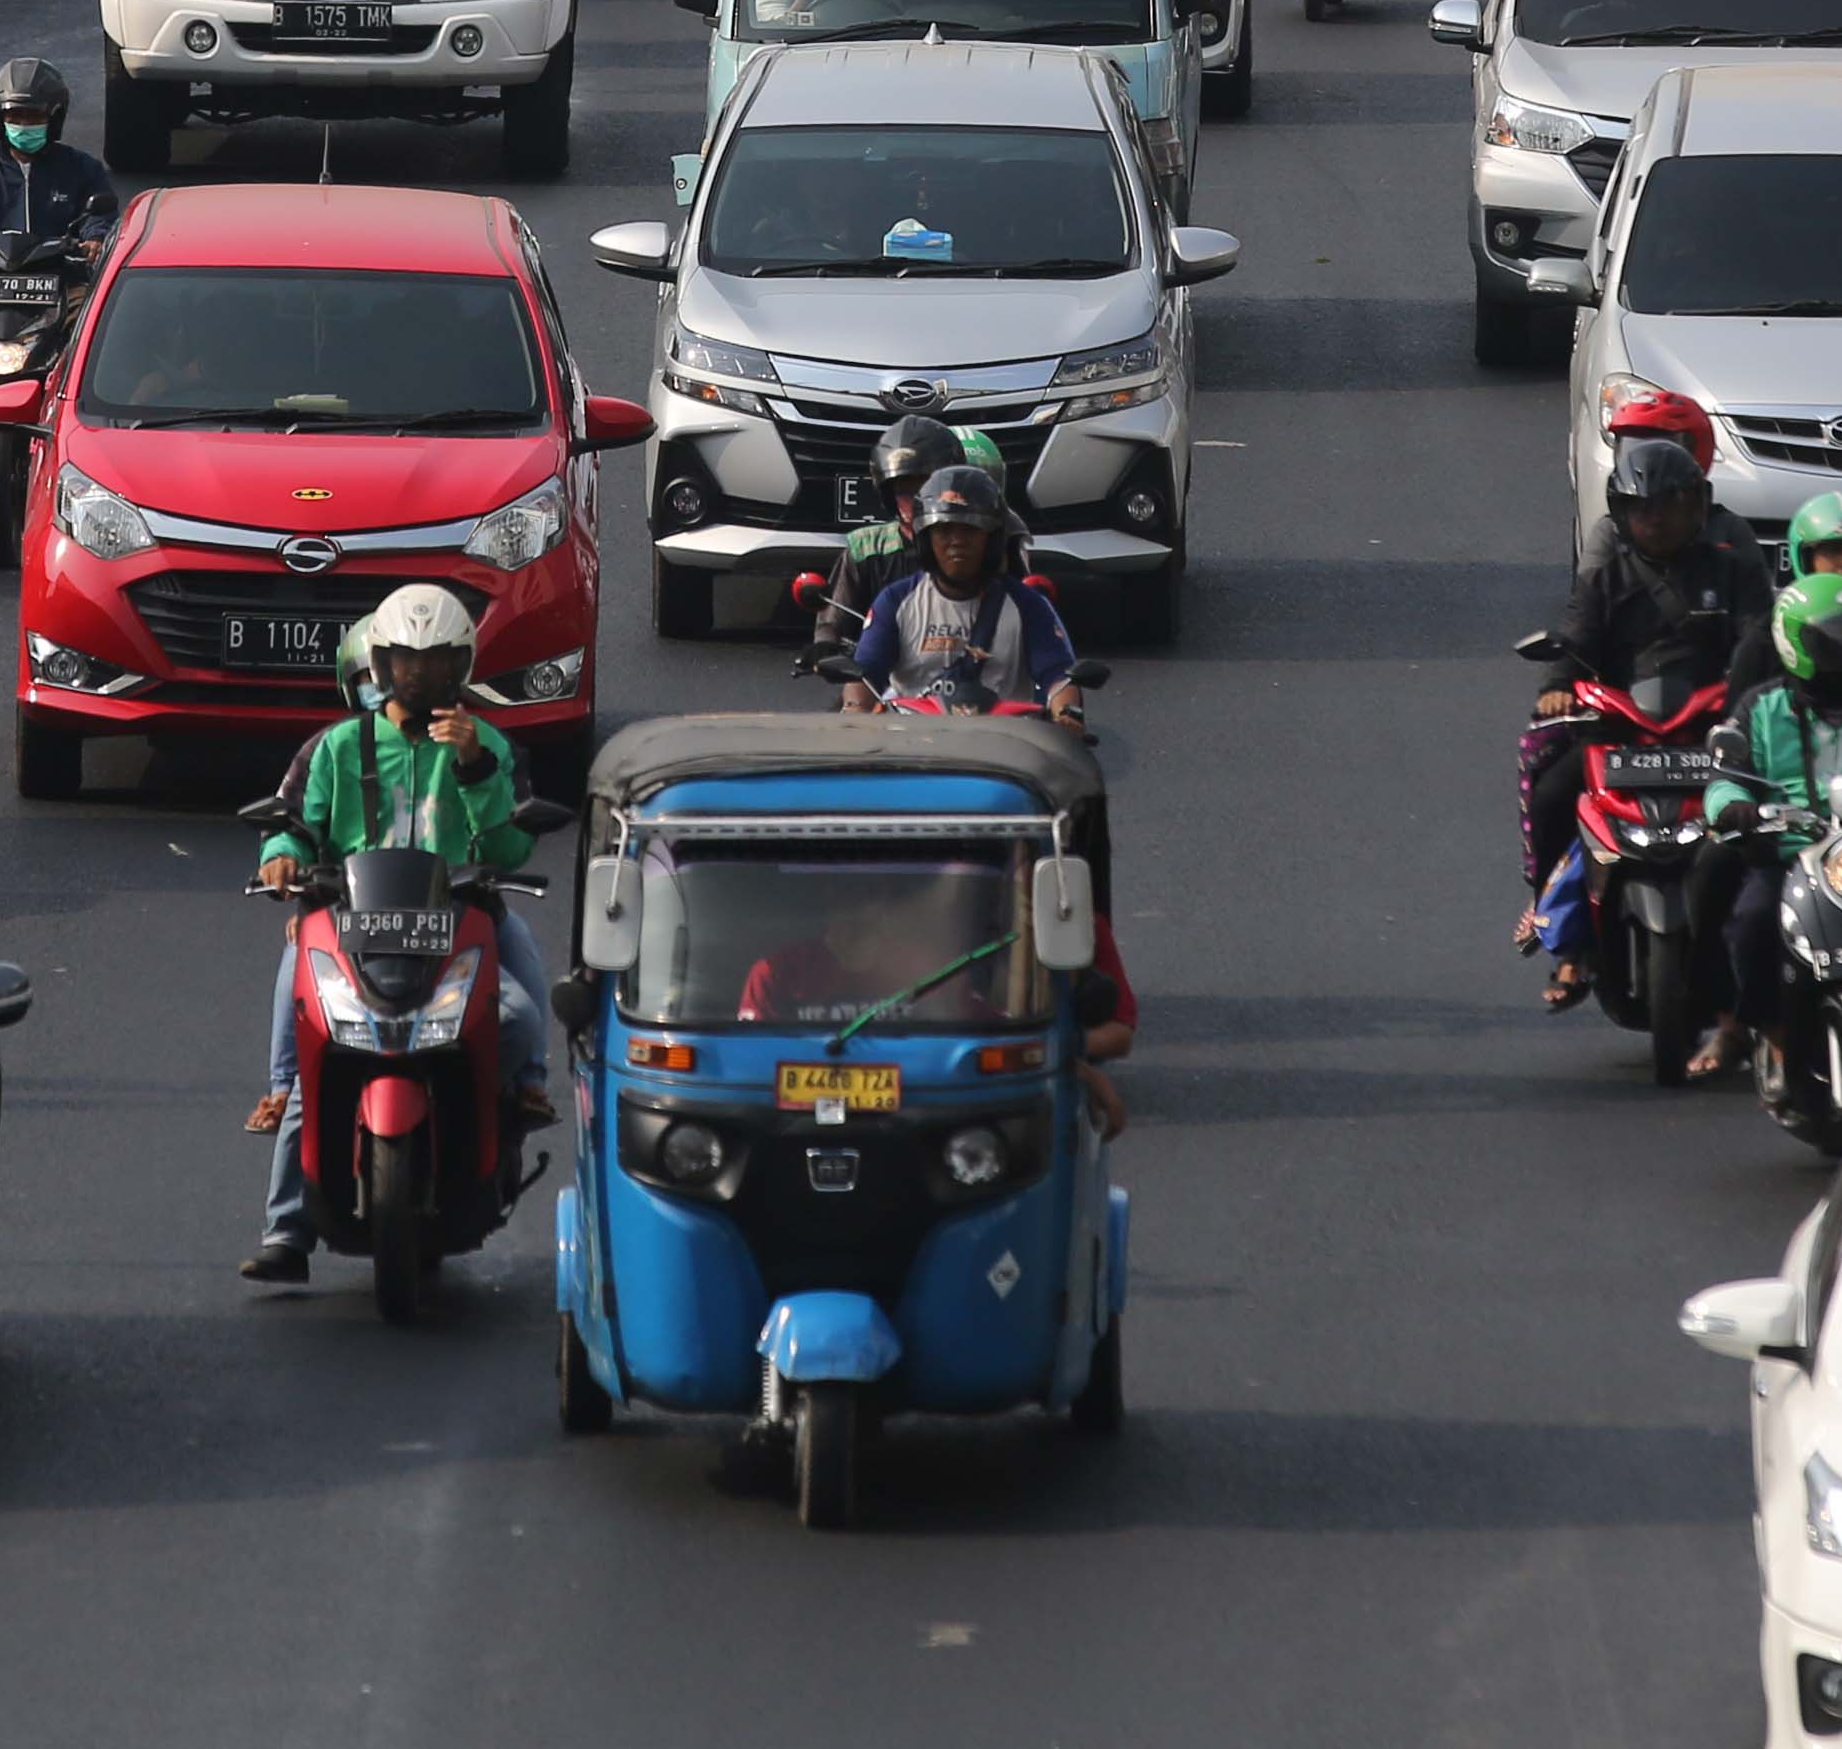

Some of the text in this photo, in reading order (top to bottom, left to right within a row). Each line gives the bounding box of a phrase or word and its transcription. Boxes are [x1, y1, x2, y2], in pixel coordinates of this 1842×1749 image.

[273, 5, 390, 27] B 1575 TMK
[26, 279, 53, 291] BKN
[845, 480, 858, 504] E
[1779, 547, 1791, 571] B
[231, 621, 320, 649] B 1104
[341, 915, 352, 933] B
[786, 1072, 797, 1088] B
